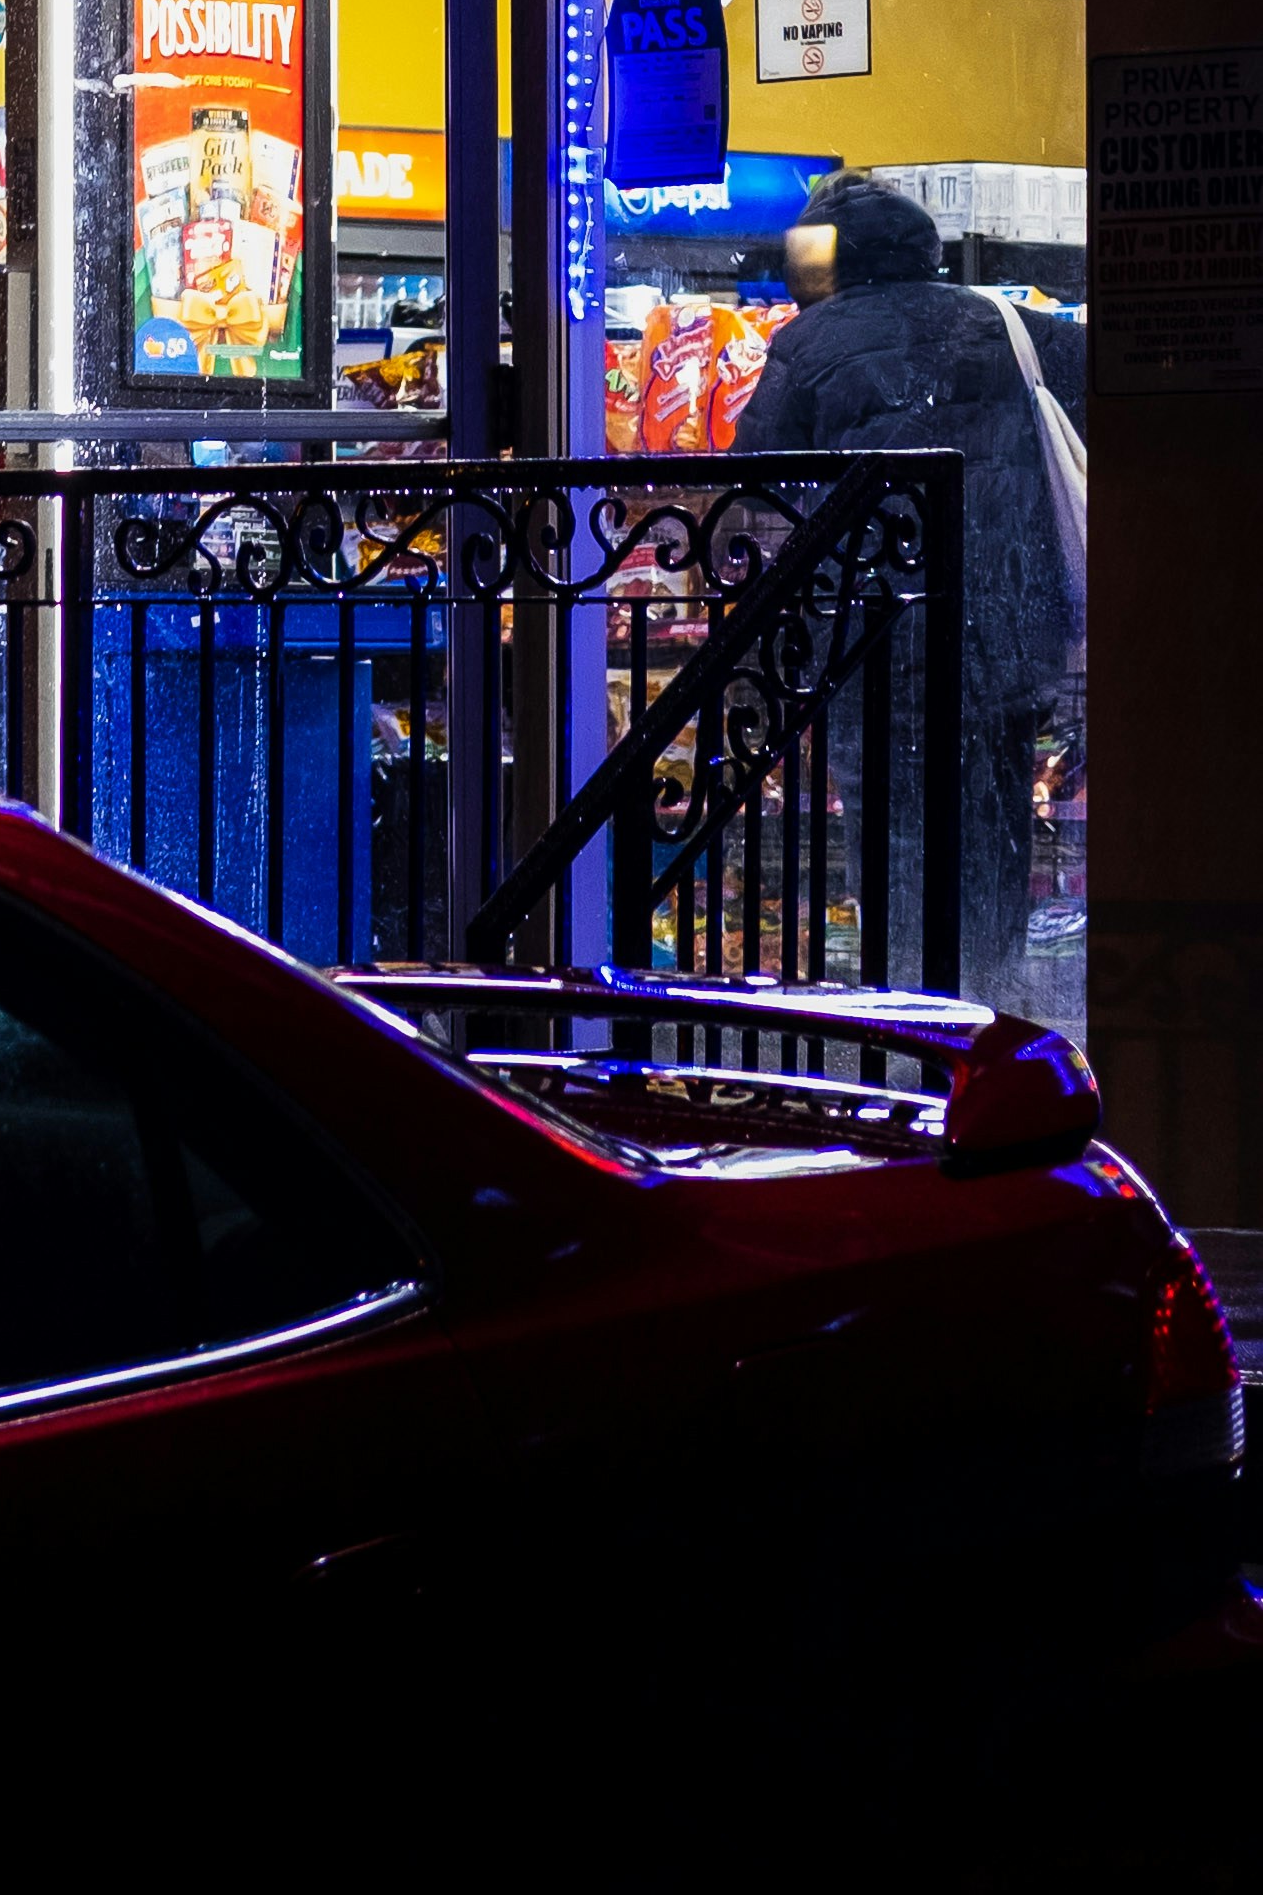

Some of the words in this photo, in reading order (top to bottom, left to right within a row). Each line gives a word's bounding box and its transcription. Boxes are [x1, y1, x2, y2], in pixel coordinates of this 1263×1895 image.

[622, 6, 708, 51] PASS
[783, 26, 799, 41] NO
[801, 21, 843, 40] VAPING
[1123, 63, 1239, 94] PRIVATE
[1105, 94, 1260, 128] PROPERTY
[203, 136, 236, 157] Gift
[1100, 129, 1263, 175] CUSTOMER
[200, 156, 243, 177] Pack
[1100, 177, 1200, 211] PARKING
[1207, 174, 1263, 206] ONLY
[1098, 228, 1137, 257] PAY
[1169, 221, 1263, 255] DISPLAY
[1099, 260, 1180, 283] ENFORCED
[1184, 259, 1203, 281] 24
[1207, 255, 1263, 279] HOURS
[1103, 299, 1198, 315] UNAUTHORIZED
[1201, 296, 1263, 312] VEHICLES
[1134, 332, 1179, 347] TOWED
